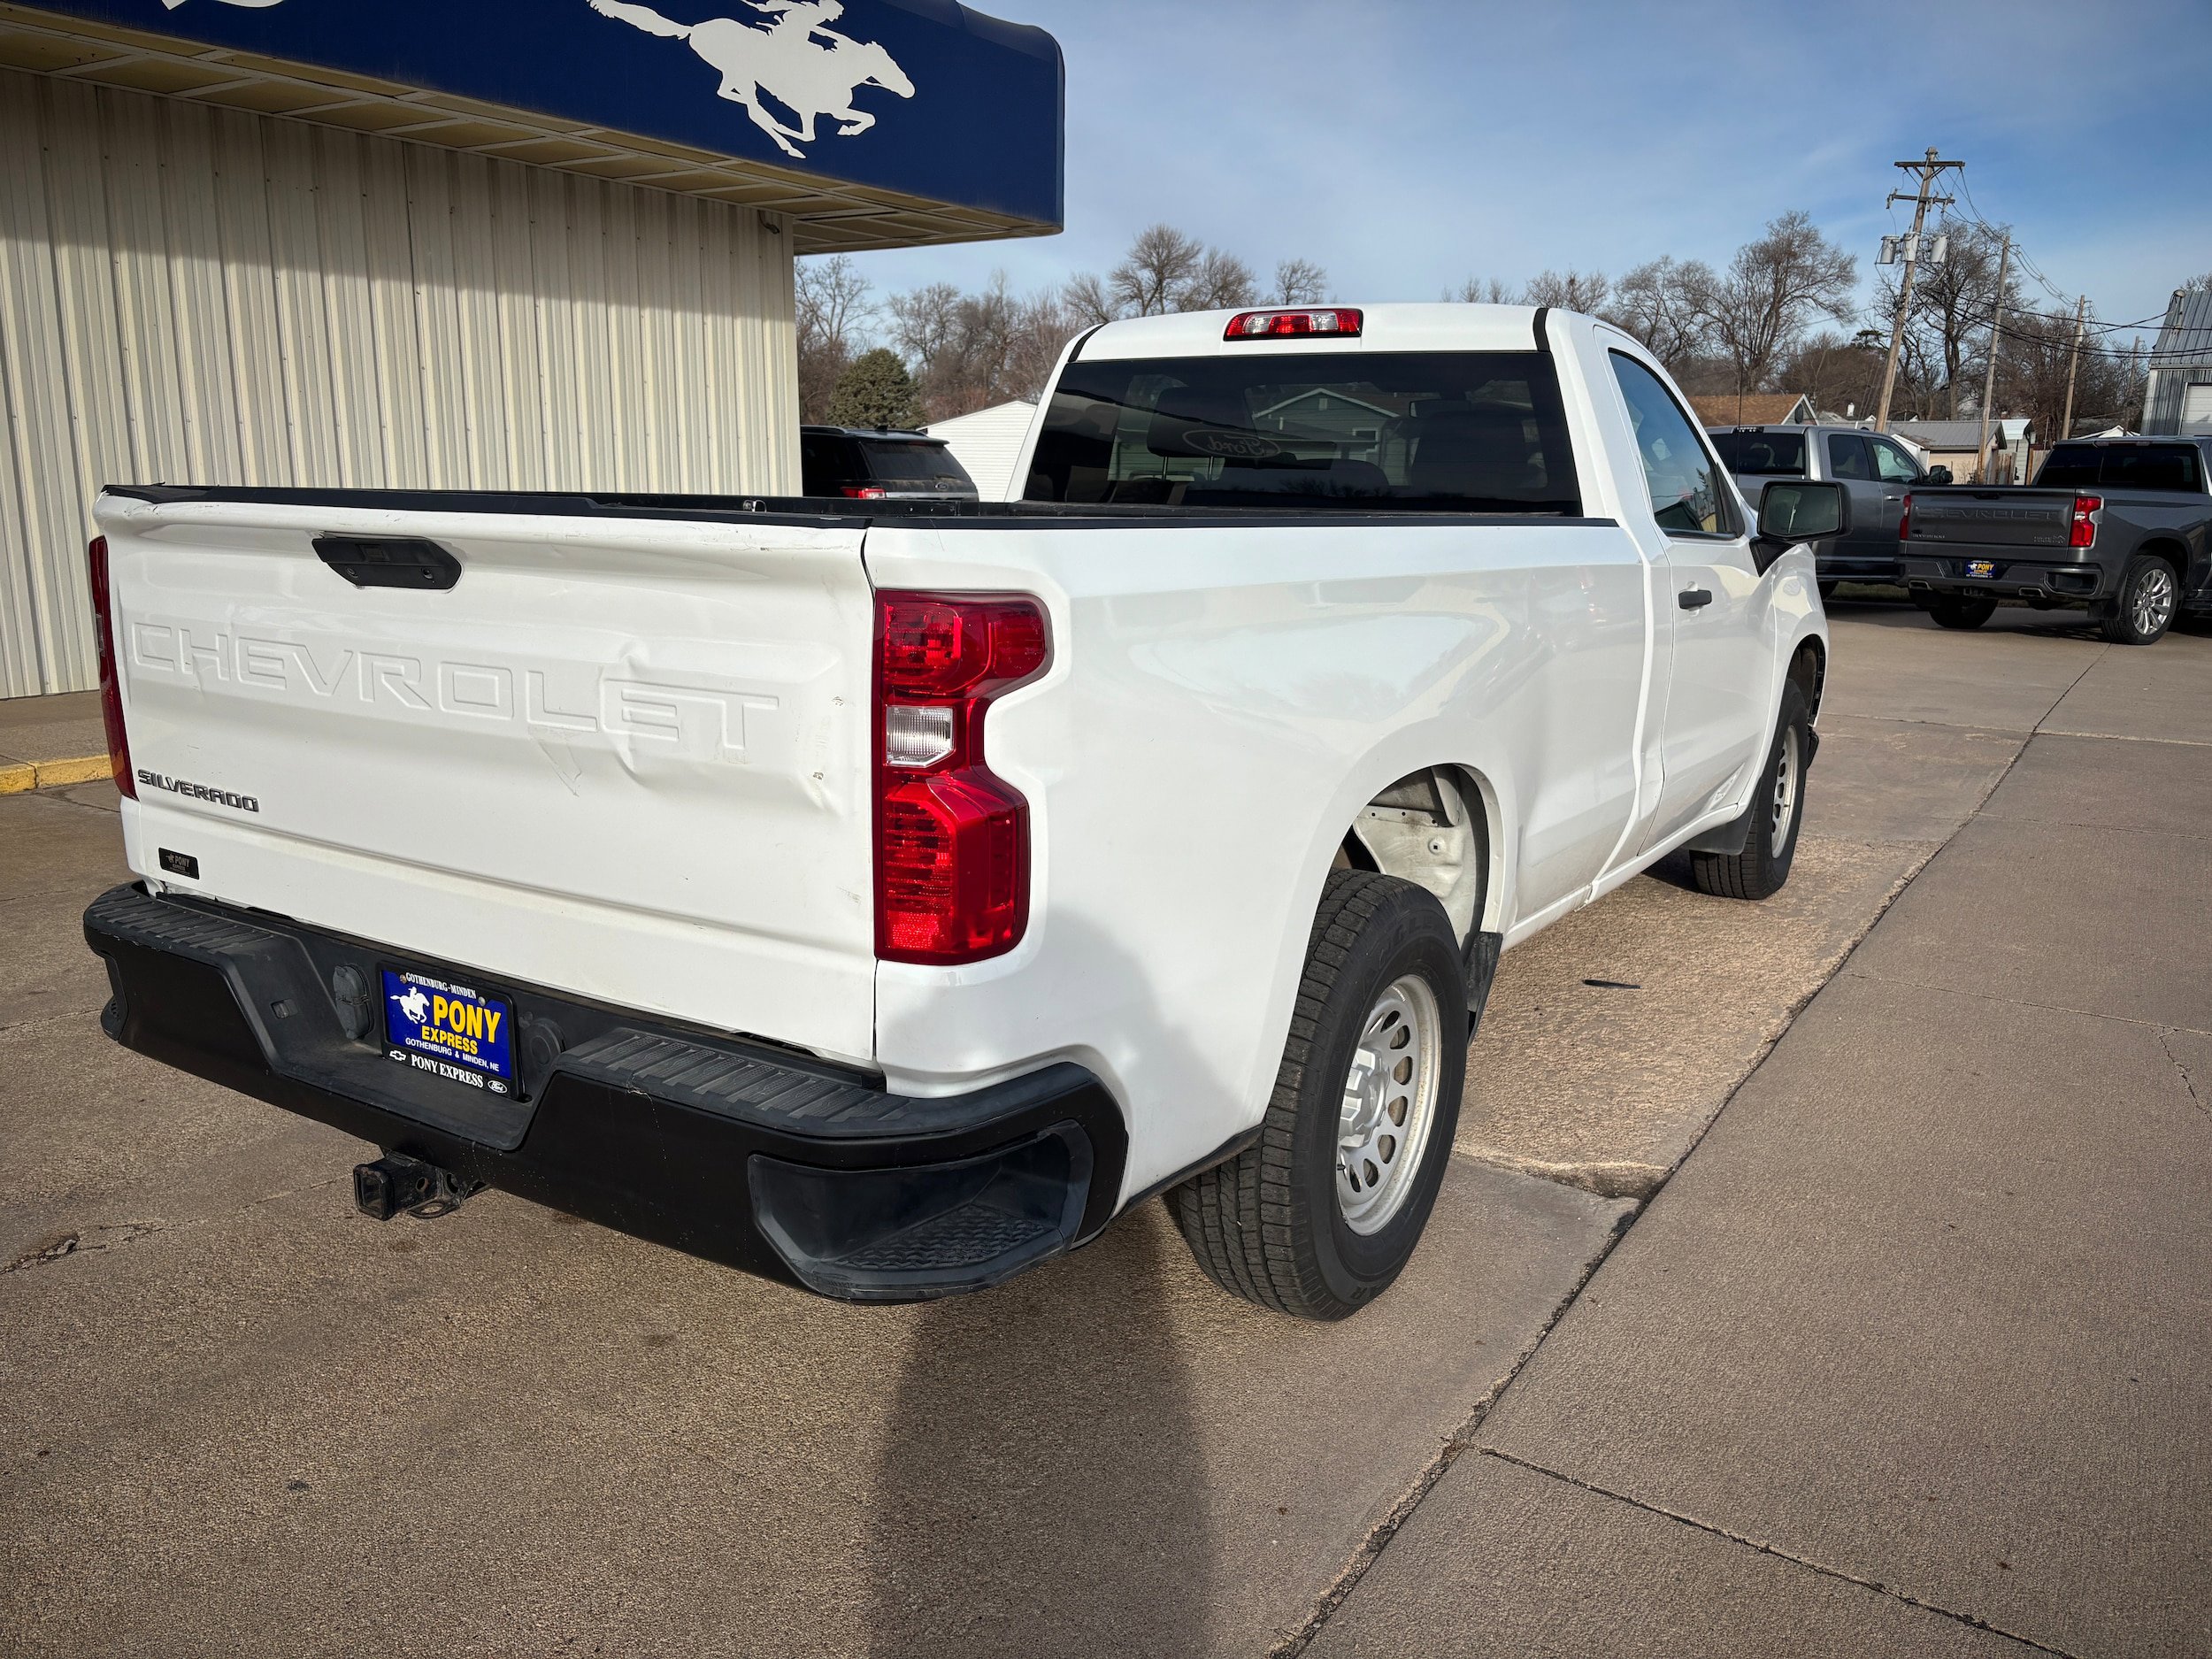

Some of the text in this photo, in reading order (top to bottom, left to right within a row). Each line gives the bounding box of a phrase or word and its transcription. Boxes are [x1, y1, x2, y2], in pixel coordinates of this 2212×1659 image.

[131, 621, 779, 750] CHEVROLET
[138, 769, 259, 812] SILVERADO
[174, 855, 190, 868] PONY
[433, 995, 502, 1043] PONY
[405, 1037, 500, 1071] GOTHENBURG & MINDEN, NE
[421, 1025, 478, 1055] EXPRESS
[411, 1053, 484, 1088] PONY EXPRESS
